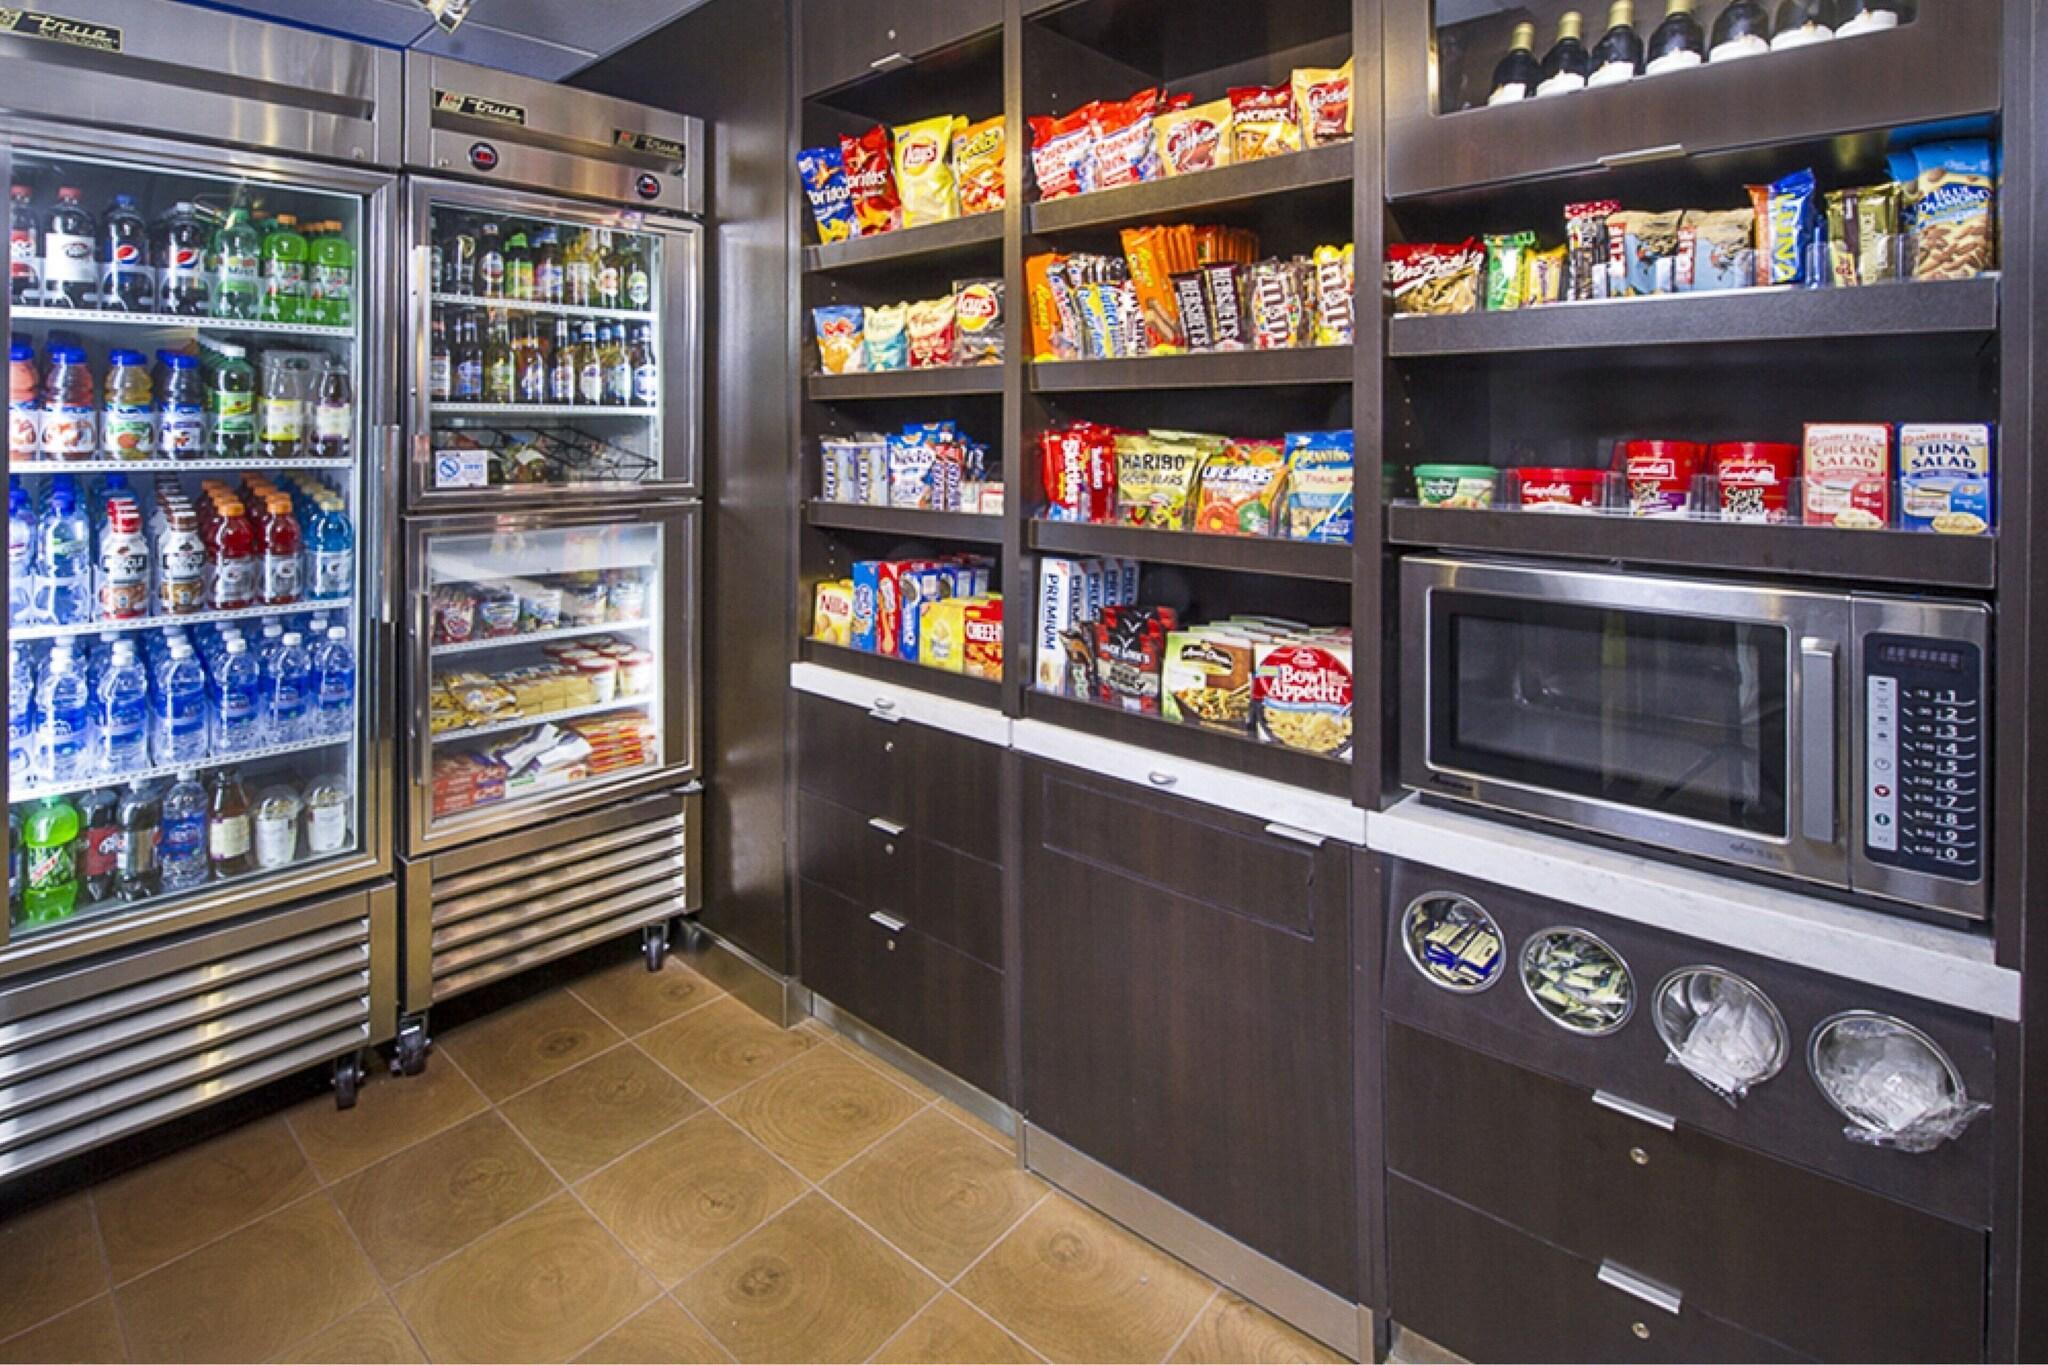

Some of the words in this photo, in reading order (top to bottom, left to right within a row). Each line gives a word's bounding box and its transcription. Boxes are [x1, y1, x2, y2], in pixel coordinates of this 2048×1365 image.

[1774, 193, 1797, 284] LUNA
[1812, 445, 1880, 458] CHICKEN
[1917, 442, 1971, 457] TUNA
[1122, 454, 1185, 471] HARIBO
[1815, 456, 1877, 468] SALAD
[1911, 456, 1977, 470] SALAD
[1062, 439, 1081, 504] Skittles
[1521, 480, 1572, 498] Campbell's
[1044, 573, 1059, 650] PREMIUM
[1280, 665, 1326, 684] Bowl
